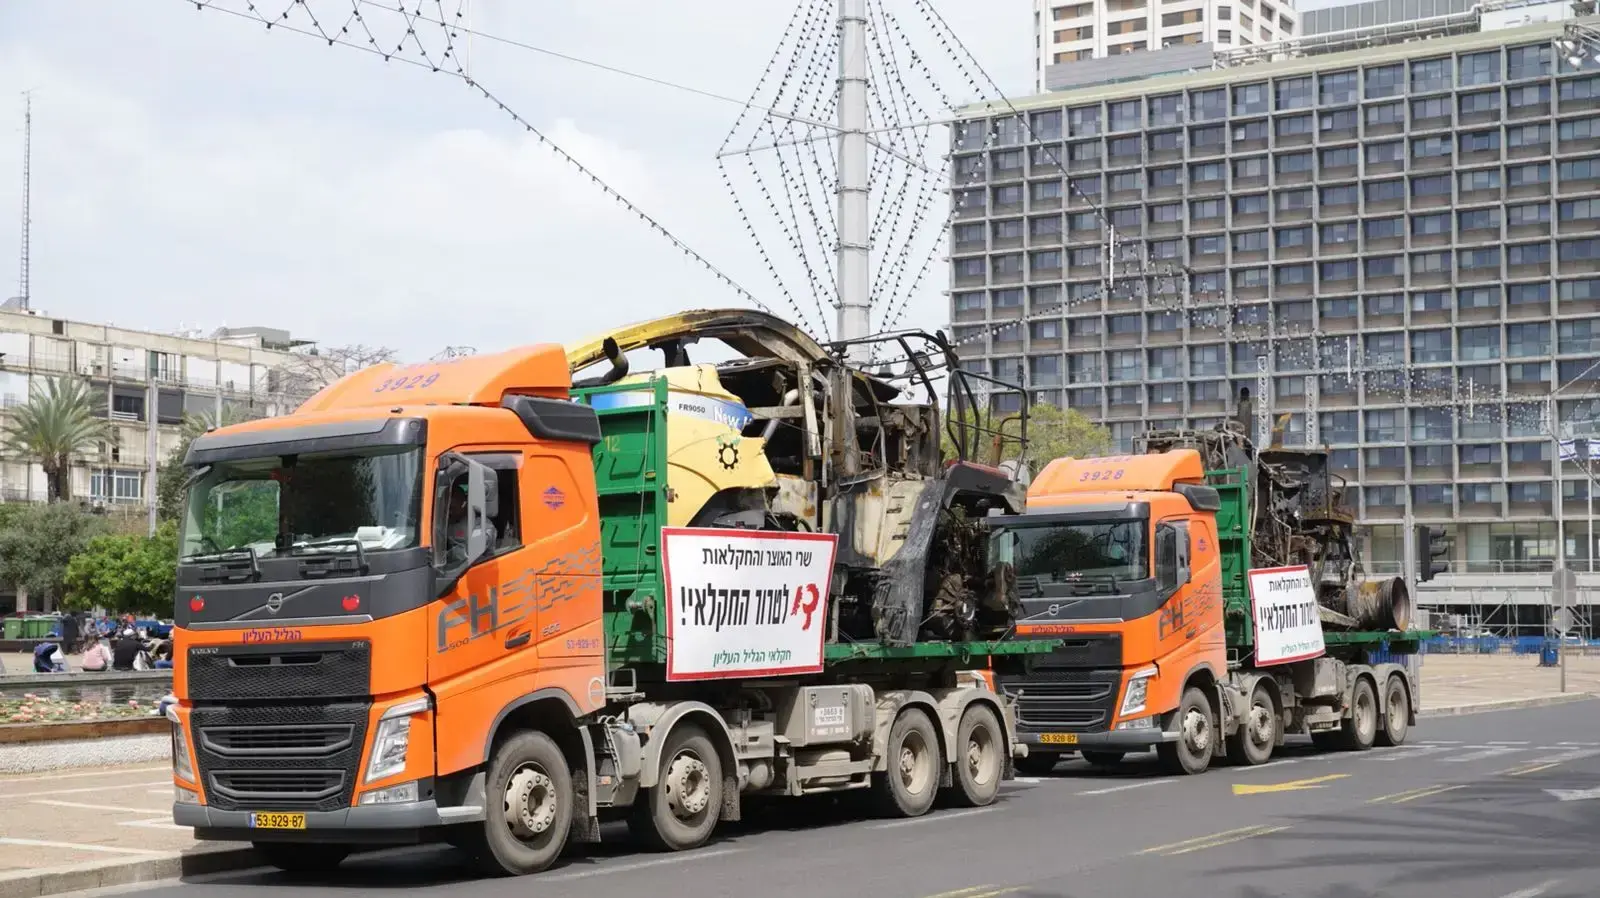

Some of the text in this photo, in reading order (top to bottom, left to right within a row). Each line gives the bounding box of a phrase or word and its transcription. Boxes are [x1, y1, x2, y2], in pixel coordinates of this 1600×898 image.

[374, 372, 440, 393] 3929
[678, 403, 706, 414] FR9050
[1079, 468, 1124, 482] 3928
[702, 544, 812, 570] שרי האוצר והחקלאות
[1268, 576, 1302, 592] והחקלאות
[681, 583, 751, 632] החקלאי!
[755, 583, 790, 625] לטרור
[1259, 602, 1298, 633] החקלאי!
[242, 628, 302, 644] הגליל העליון
[713, 648, 792, 667] חקלאי הגליל העליון
